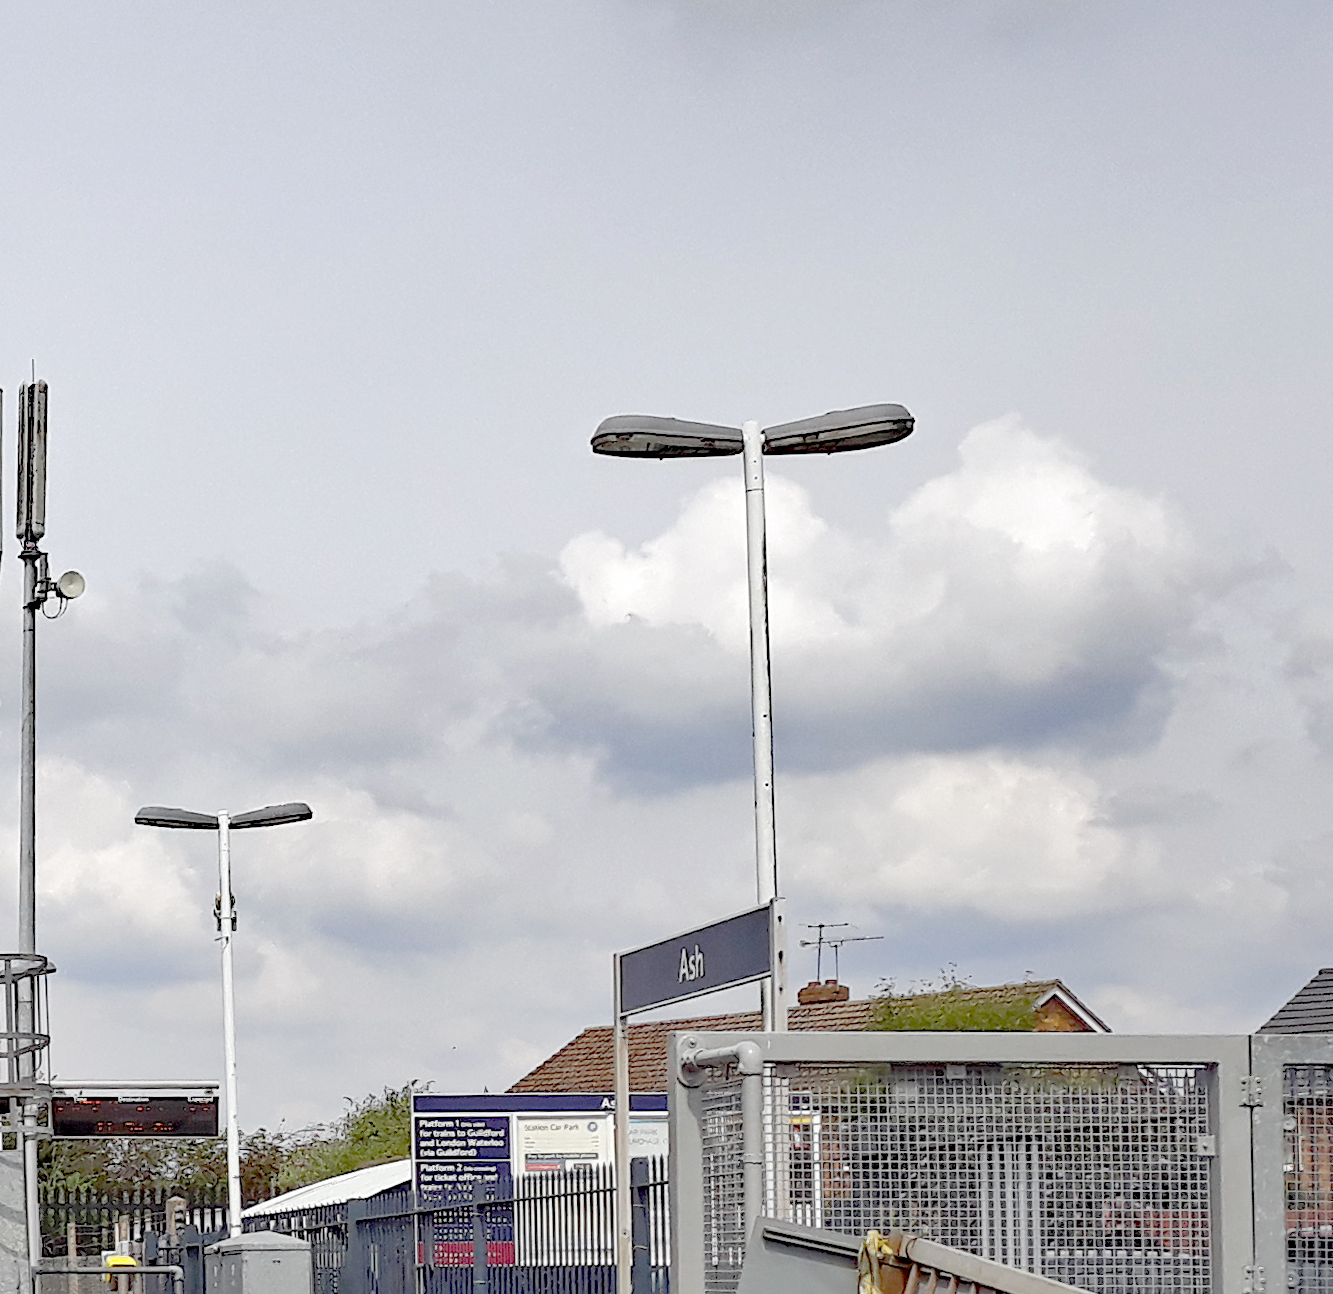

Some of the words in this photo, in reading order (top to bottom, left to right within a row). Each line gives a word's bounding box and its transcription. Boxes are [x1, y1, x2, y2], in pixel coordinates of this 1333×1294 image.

[678, 944, 705, 983] Ash
[601, 1097, 616, 1109] As
[419, 1119, 454, 1128] Platform
[563, 1123, 580, 1131] Park
[419, 1129, 433, 1138] for
[433, 1129, 456, 1138] trains
[456, 1129, 466, 1138] to
[419, 1138, 435, 1147] and
[436, 1138, 466, 1147] London
[467, 1138, 504, 1148] Waterloo
[420, 1163, 455, 1172] Platform
[456, 1163, 462, 1172] 2
[420, 1173, 433, 1182] for
